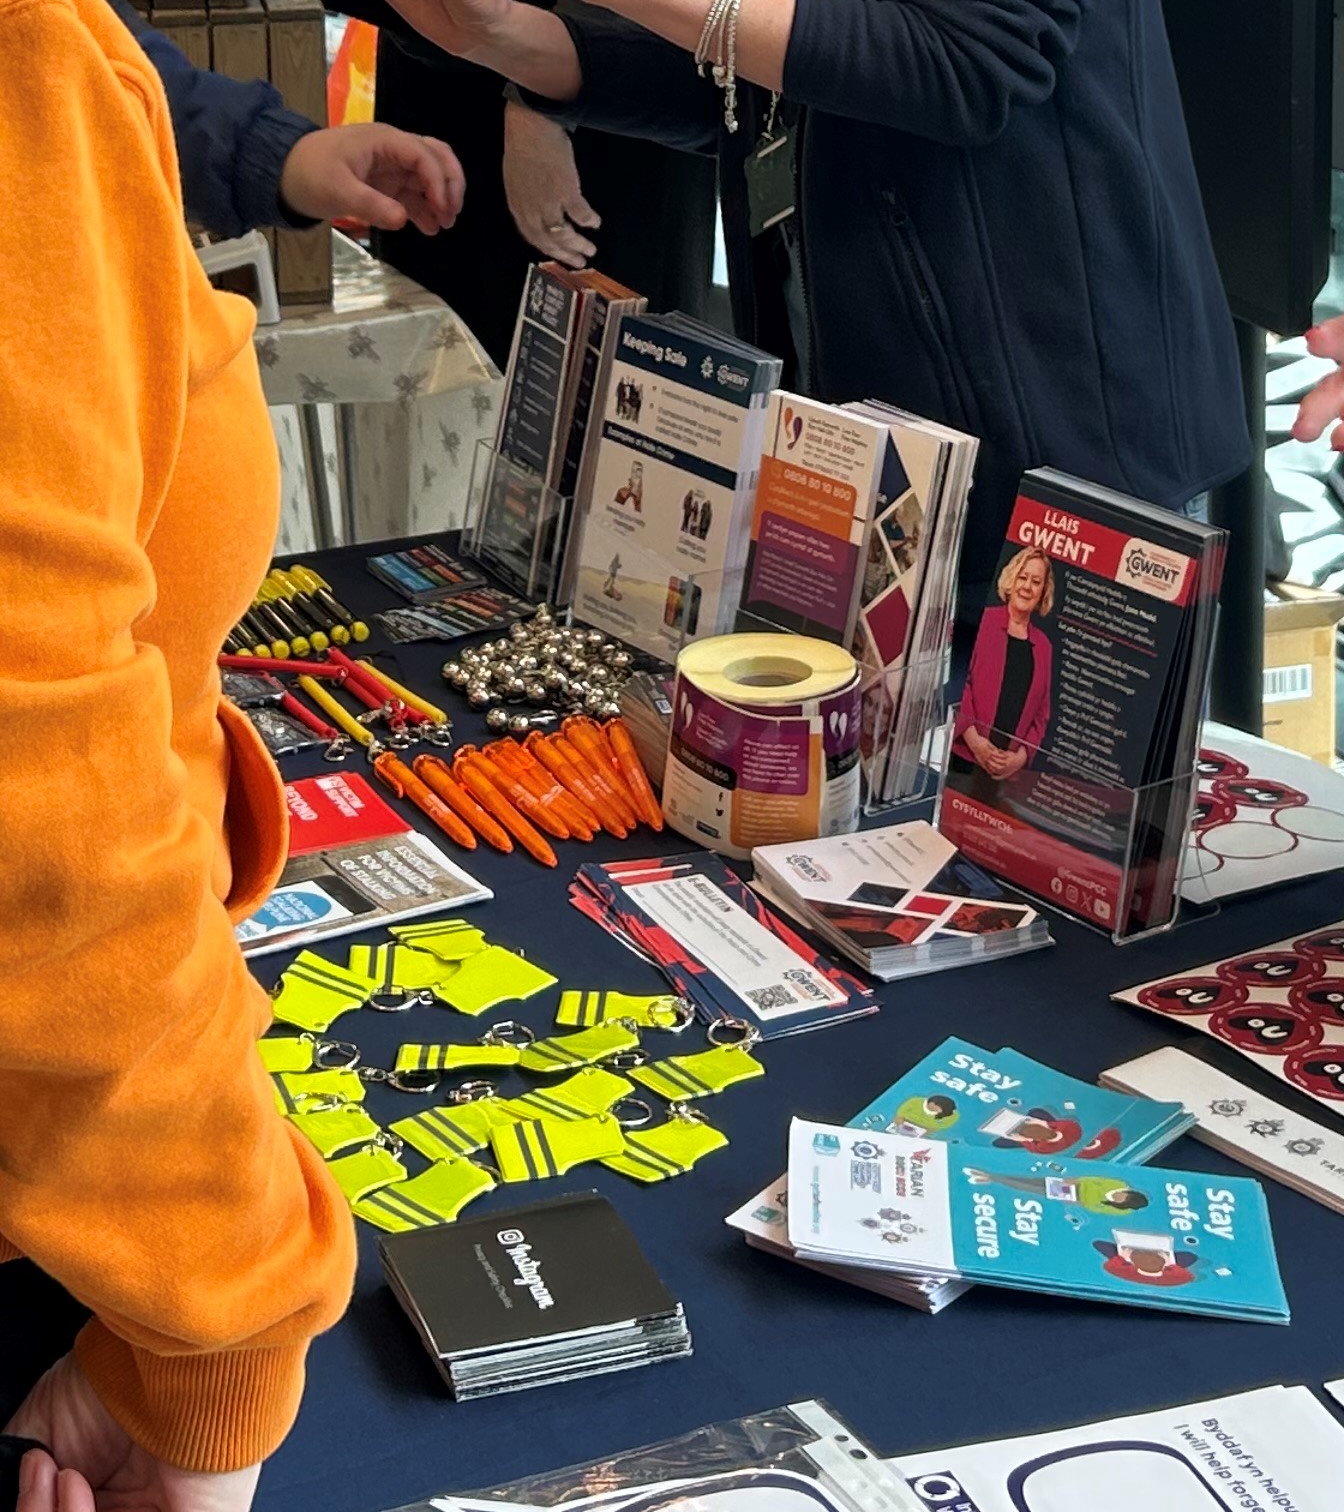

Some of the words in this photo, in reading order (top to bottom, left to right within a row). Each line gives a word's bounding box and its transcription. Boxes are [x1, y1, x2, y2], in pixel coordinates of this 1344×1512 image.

[622, 331, 664, 363] Keeping
[1018, 521, 1096, 566] GWENT
[1044, 509, 1081, 535] LLAIS
[1131, 555, 1180, 585] GWENT
[929, 1070, 999, 1104] safe
[948, 1053, 1023, 1090] Stay
[972, 1192, 1002, 1259] secure
[1009, 1197, 1044, 1247] Stay
[1165, 1182, 1200, 1232] safe
[1203, 1187, 1236, 1241] Stay
[506, 1243, 555, 1310] Instagram
[1180, 1428, 1209, 1454] will
[1201, 1448, 1232, 1479] help
[1202, 1417, 1250, 1463] Byddaf
[1242, 1457, 1263, 1479] yn
